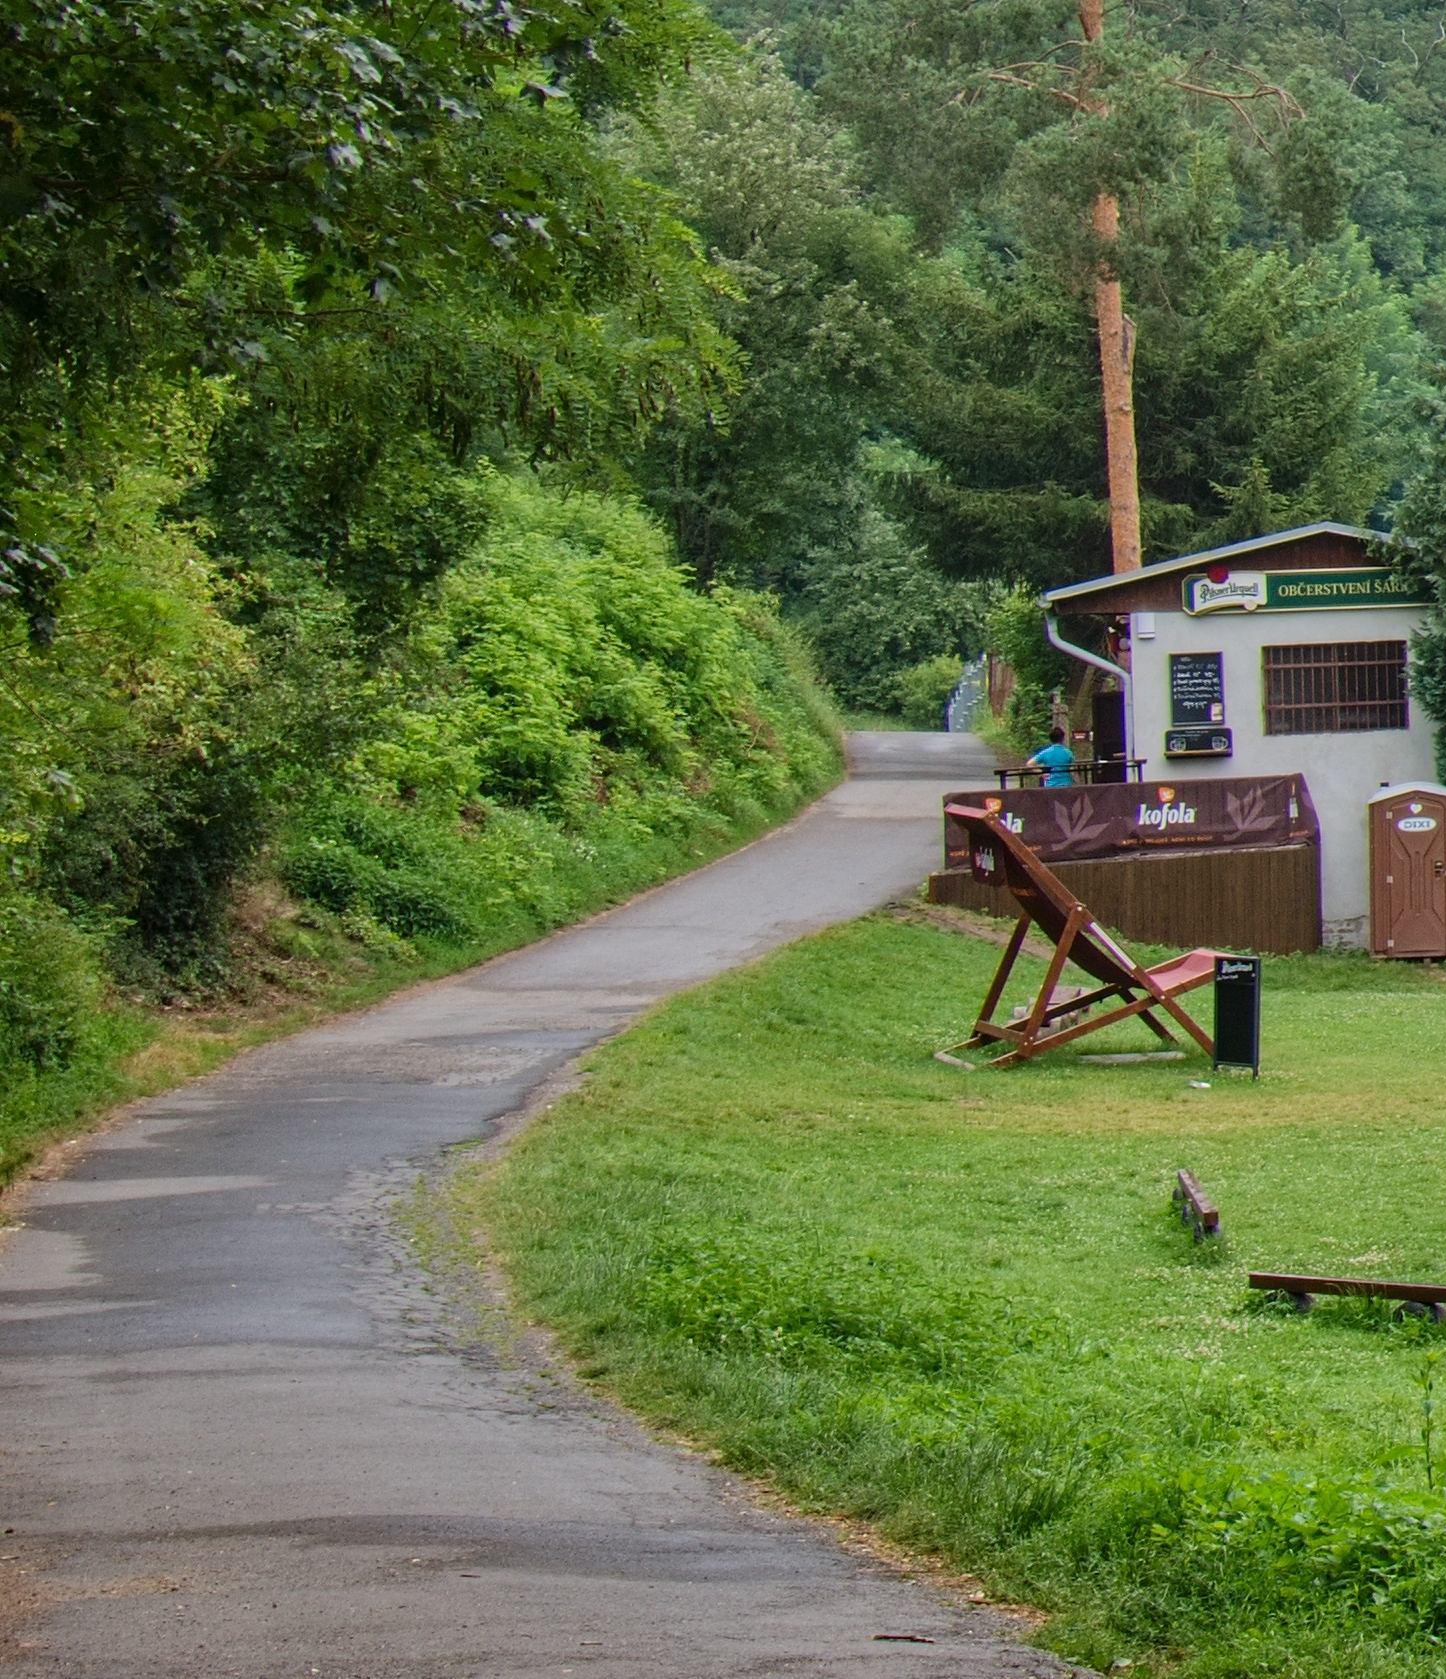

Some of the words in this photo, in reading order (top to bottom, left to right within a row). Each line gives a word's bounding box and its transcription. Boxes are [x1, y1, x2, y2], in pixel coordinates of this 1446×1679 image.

[1278, 580, 1371, 597] OBČERSTVENÍ
[1138, 802, 1195, 830] kofola
[1403, 820, 1430, 829] DIXI
